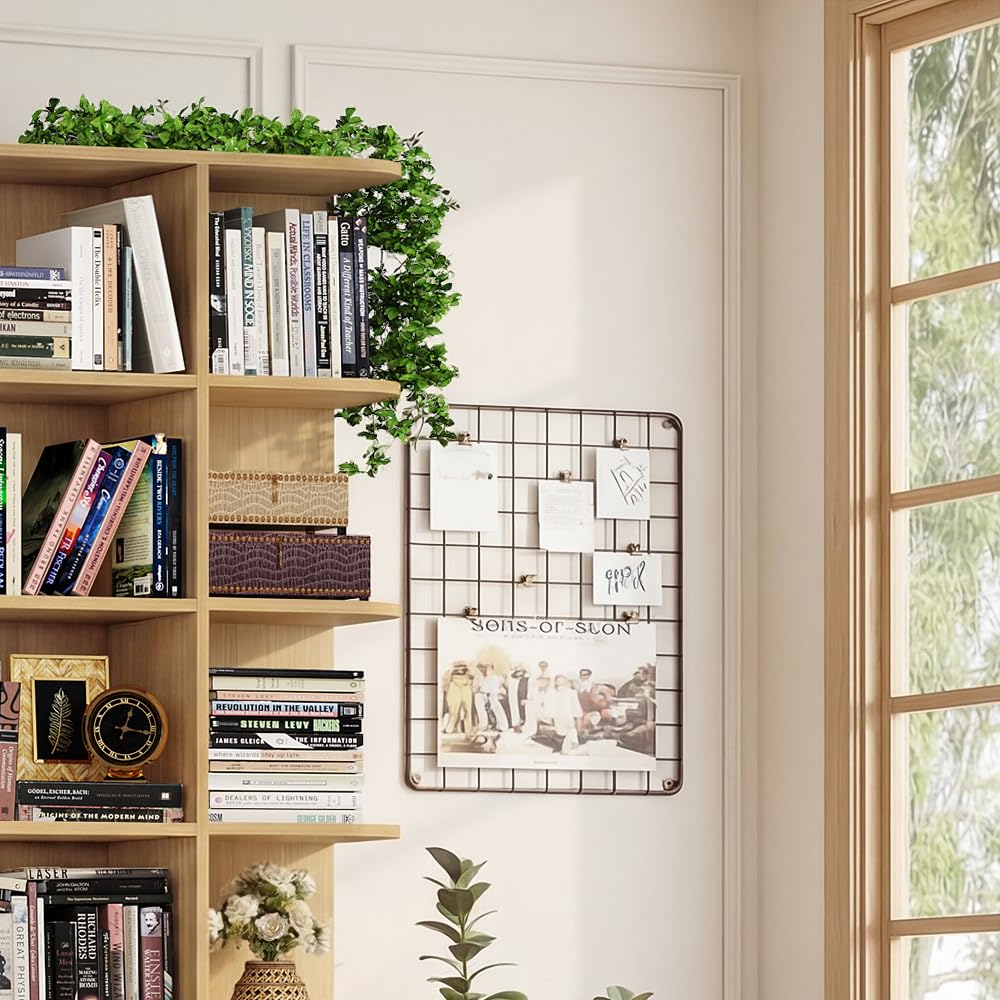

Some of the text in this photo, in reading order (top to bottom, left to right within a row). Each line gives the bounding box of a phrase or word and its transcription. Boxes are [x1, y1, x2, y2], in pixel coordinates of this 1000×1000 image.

[341, 222, 350, 247] Gatto
[244, 264, 253, 287] MIND
[303, 254, 311, 312] CLASSROOMS
[342, 265, 350, 296] Different
[7, 311, 40, 320] electrons
[216, 703, 270, 712] REVOLUTION
[285, 704, 300, 712] THE
[303, 705, 334, 713] VALLEY
[240, 720, 310, 729] STEVEN LEVY
[29, 869, 69, 879] LASER
[16, 926, 24, 961] GREAT
[78, 913, 87, 960] RHODES
[87, 913, 97, 960] RICHARD
[113, 942, 122, 969] WIND
